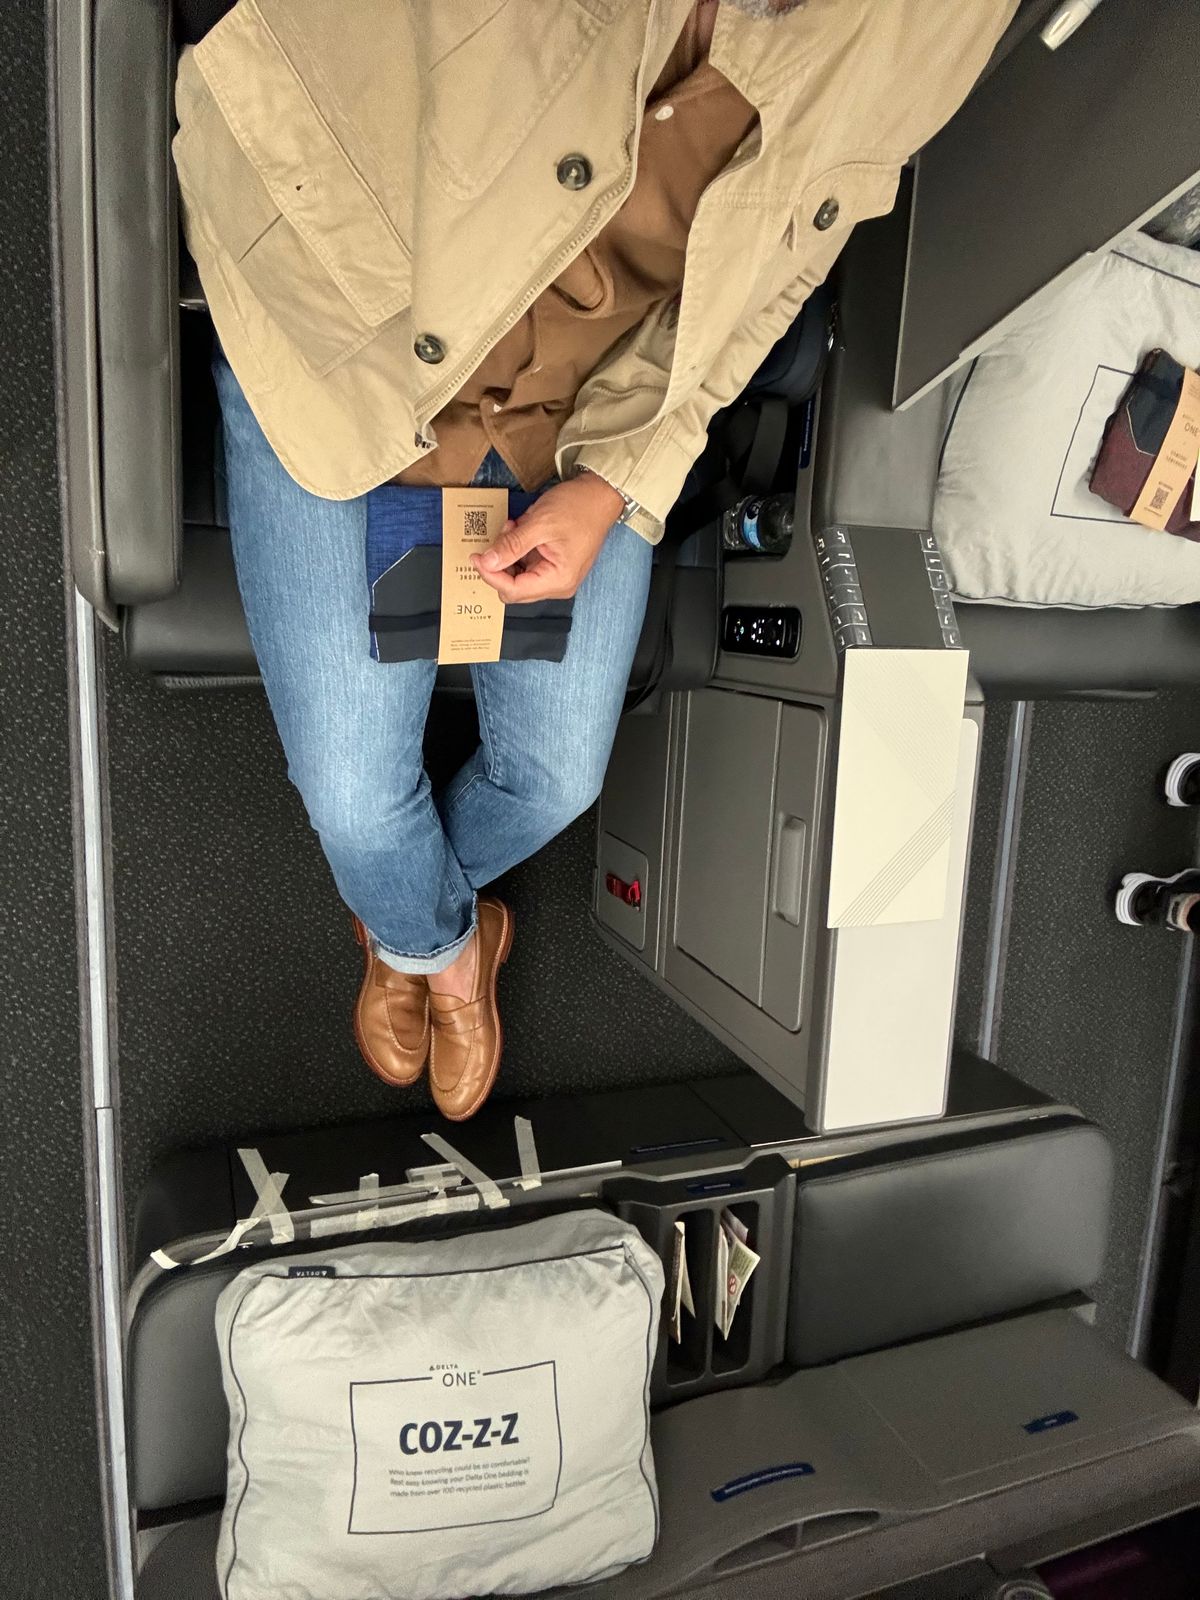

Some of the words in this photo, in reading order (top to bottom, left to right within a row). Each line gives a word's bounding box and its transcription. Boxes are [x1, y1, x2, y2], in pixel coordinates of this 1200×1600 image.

[457, 604, 483, 615] ONE
[399, 1412, 520, 1455] COZ-Z-Z
[424, 1466, 453, 1476] recycling
[454, 1464, 471, 1472] could
[421, 1479, 449, 1487] knowing
[465, 1473, 482, 1481] Delta
[483, 1472, 497, 1480] One
[456, 1484, 482, 1494] recycled
